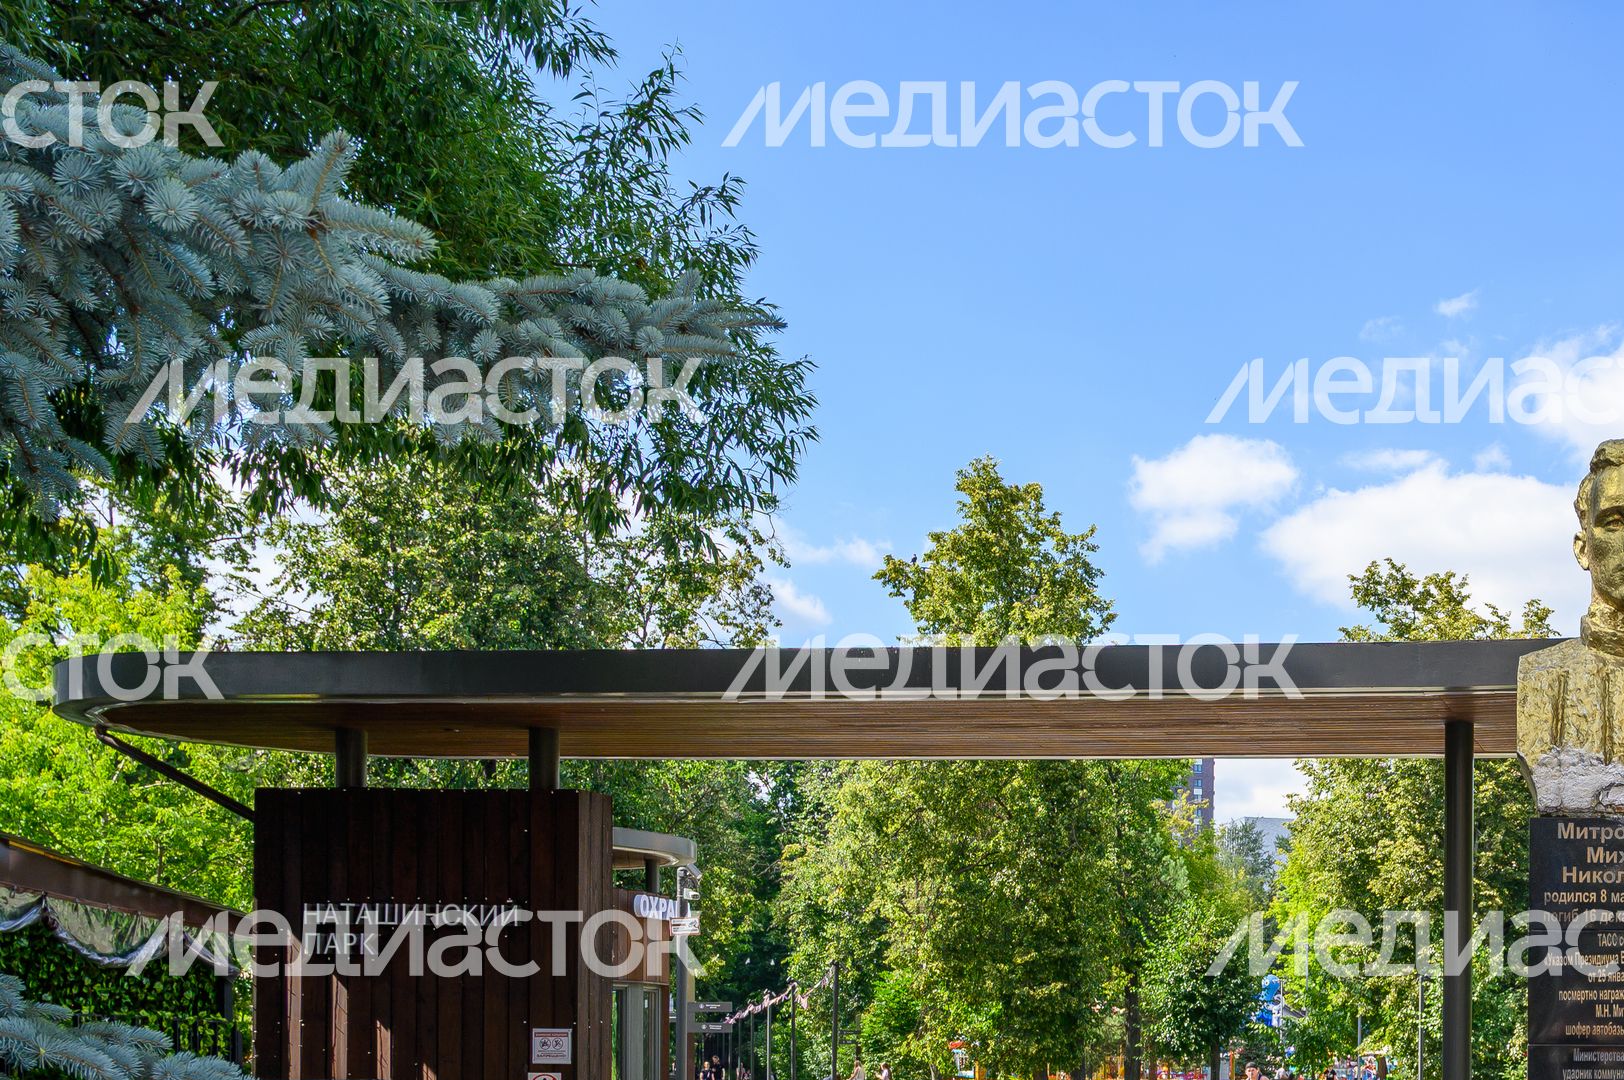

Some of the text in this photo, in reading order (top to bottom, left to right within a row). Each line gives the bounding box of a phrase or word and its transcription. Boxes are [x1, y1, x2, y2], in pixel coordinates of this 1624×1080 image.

[1544, 891, 1597, 905] родился
[1600, 891, 1607, 903] 8
[303, 899, 518, 926] НАТАШИНСКИЙ
[634, 895, 691, 919] ОХРА
[1544, 910, 1579, 923] погиб
[1584, 910, 1596, 923] 16
[304, 932, 376, 955] ПАРК
[1597, 934, 1618, 947] ТАСС
[1575, 951, 1619, 968] Президиума
[1558, 990, 1597, 1003] посмертно
[1565, 1022, 1590, 1038] шофер
[1573, 1048, 1624, 1064] Министерства
